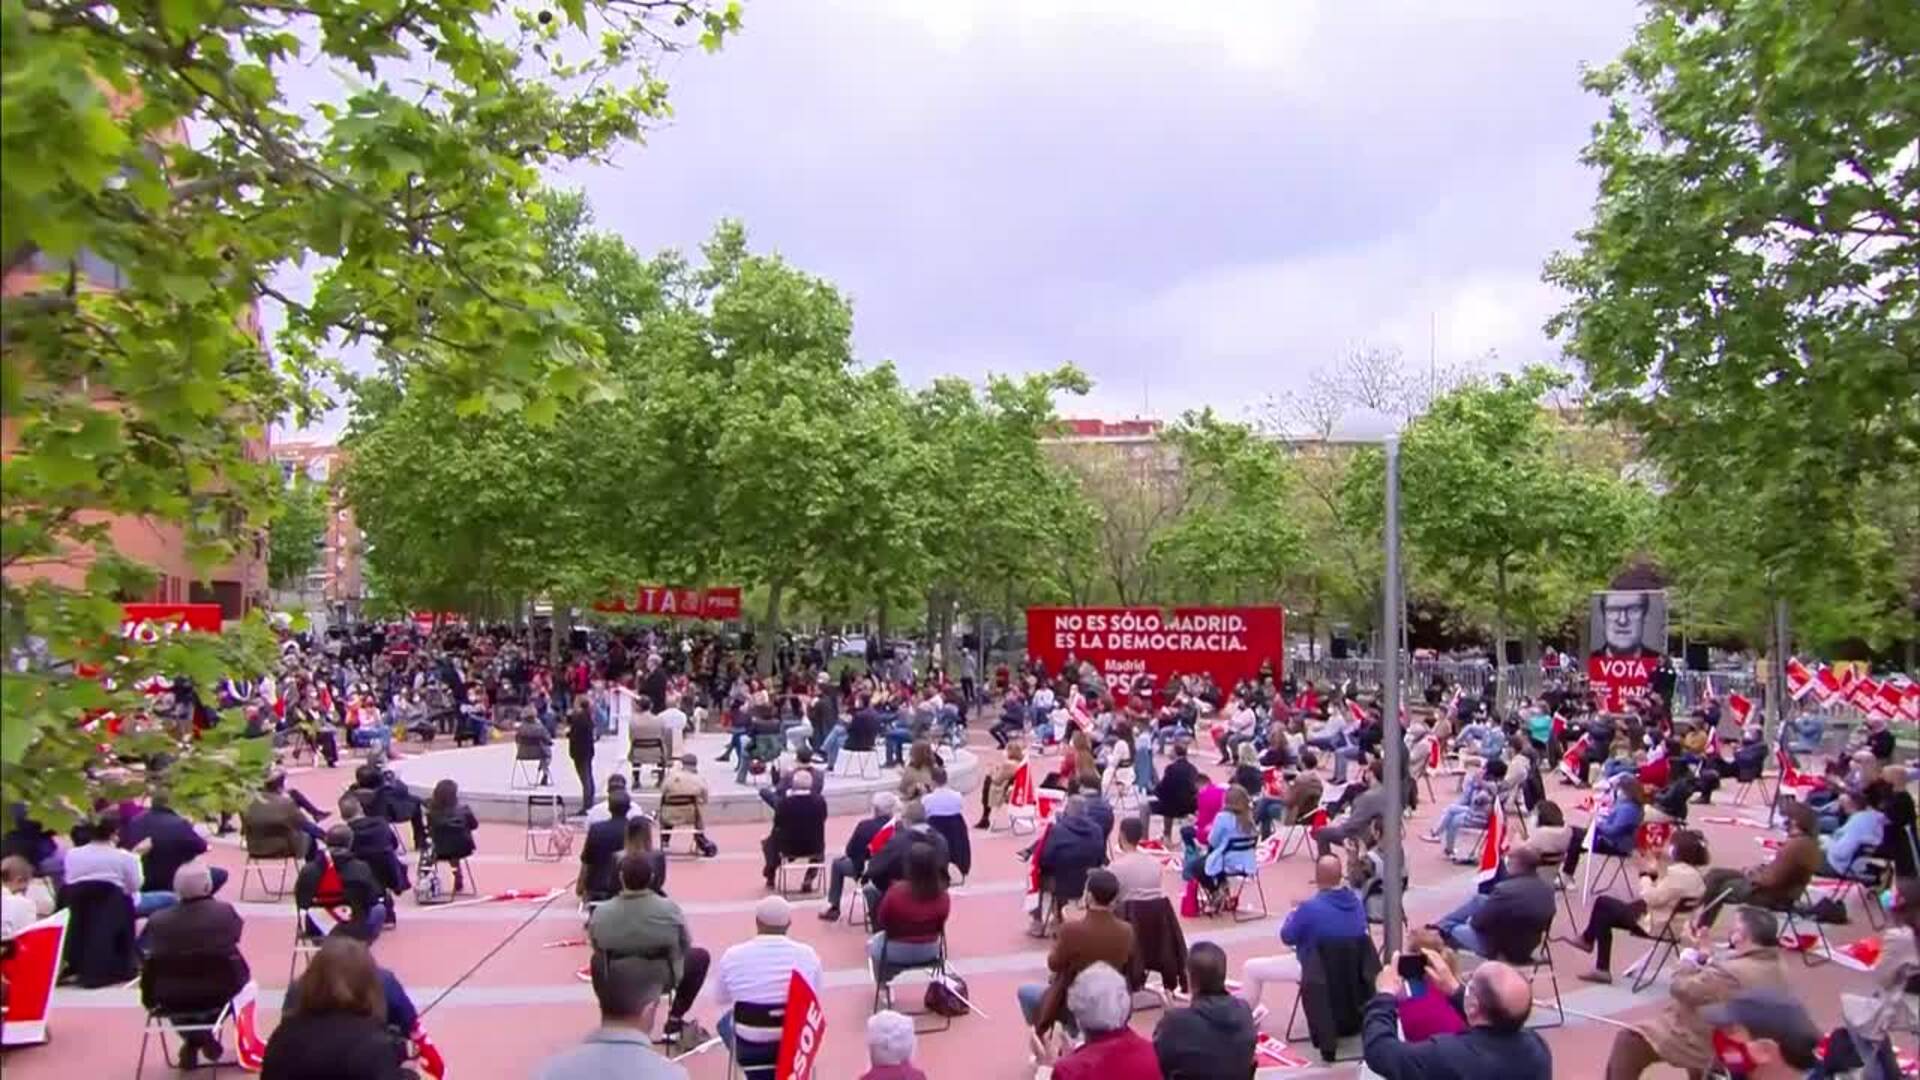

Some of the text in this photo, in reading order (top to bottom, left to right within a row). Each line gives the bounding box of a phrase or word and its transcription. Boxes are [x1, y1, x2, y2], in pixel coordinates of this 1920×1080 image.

[1055, 615, 1082, 632] NO
[1087, 615, 1106, 632] ES
[1110, 612, 1159, 632] SÓLO
[1055, 633, 1248, 651] ES LA DEMOCRACIA.
[1105, 659, 1146, 672] Madrid
[1600, 660, 1648, 678] VOTA
[1106, 674, 1158, 695] PS
